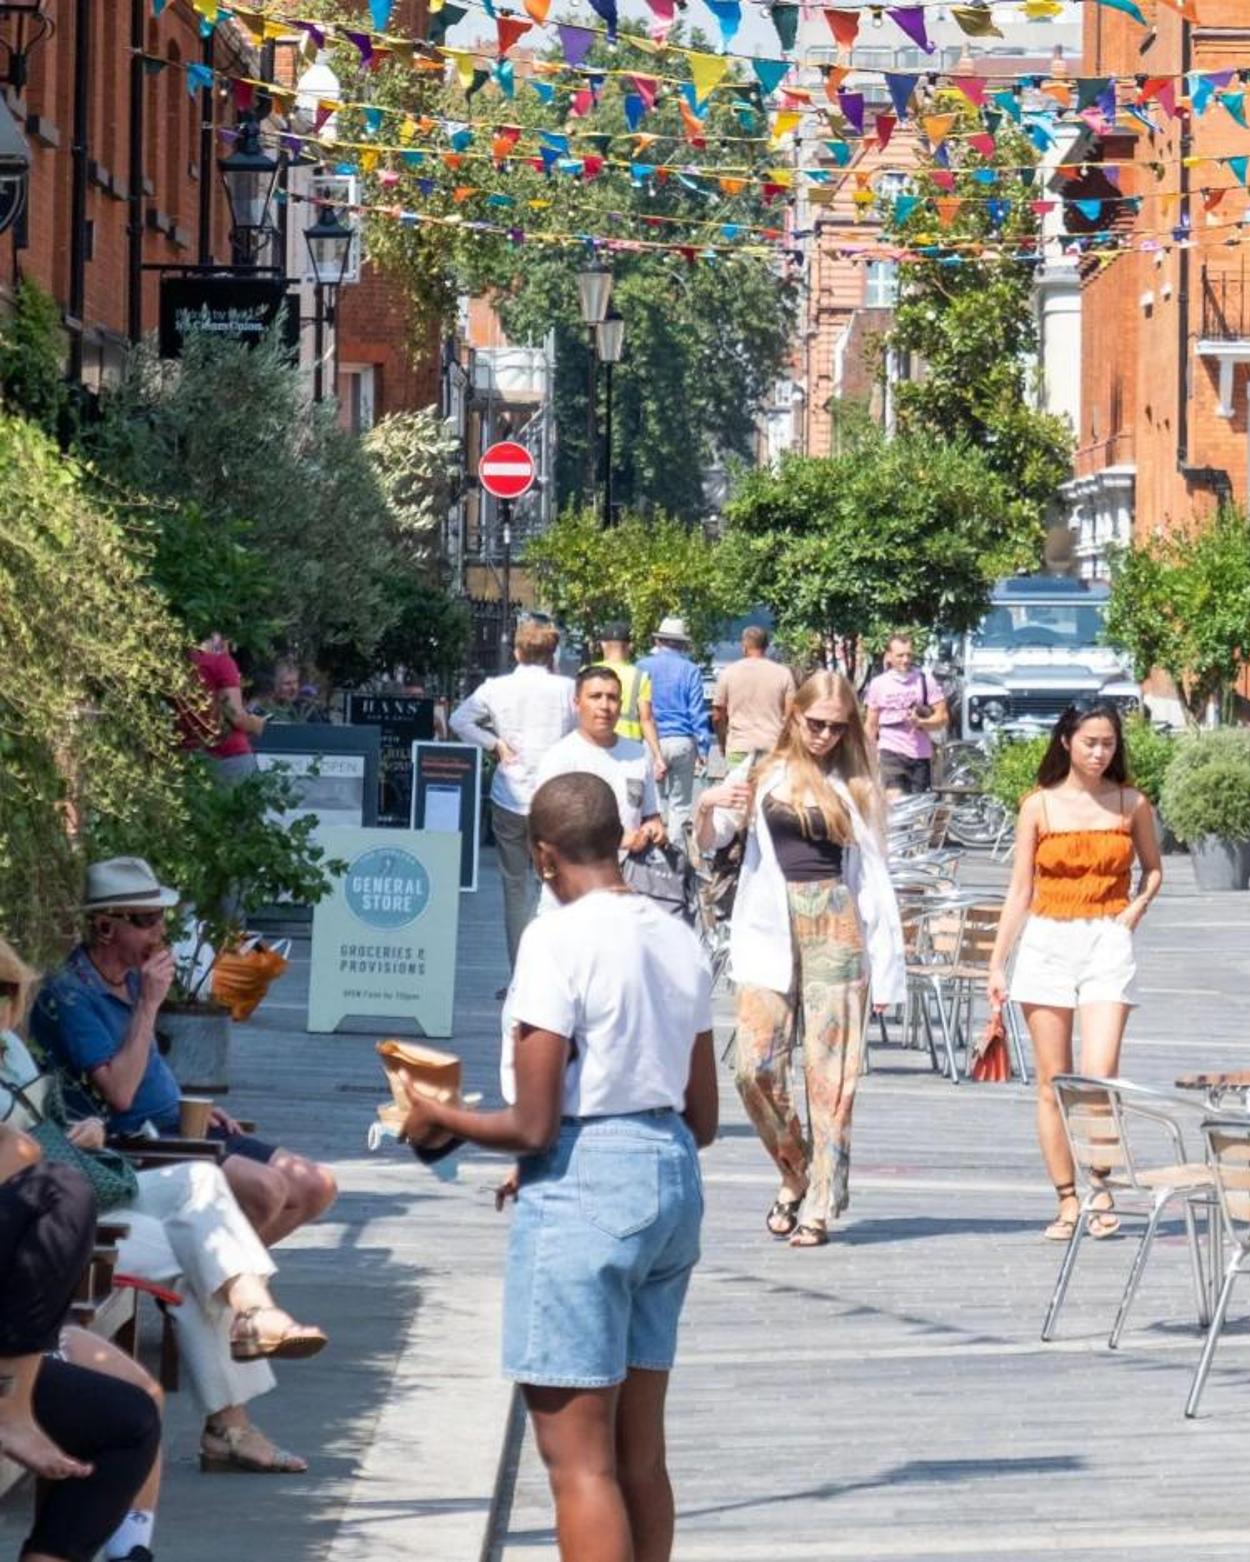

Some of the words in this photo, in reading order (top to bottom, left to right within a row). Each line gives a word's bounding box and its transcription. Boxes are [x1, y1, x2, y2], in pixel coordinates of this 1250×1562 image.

[352, 876, 422, 895] GENERAL
[362, 895, 413, 912] STORE
[340, 945, 411, 960] GROCERIES
[340, 960, 425, 975] PROVISIONS
